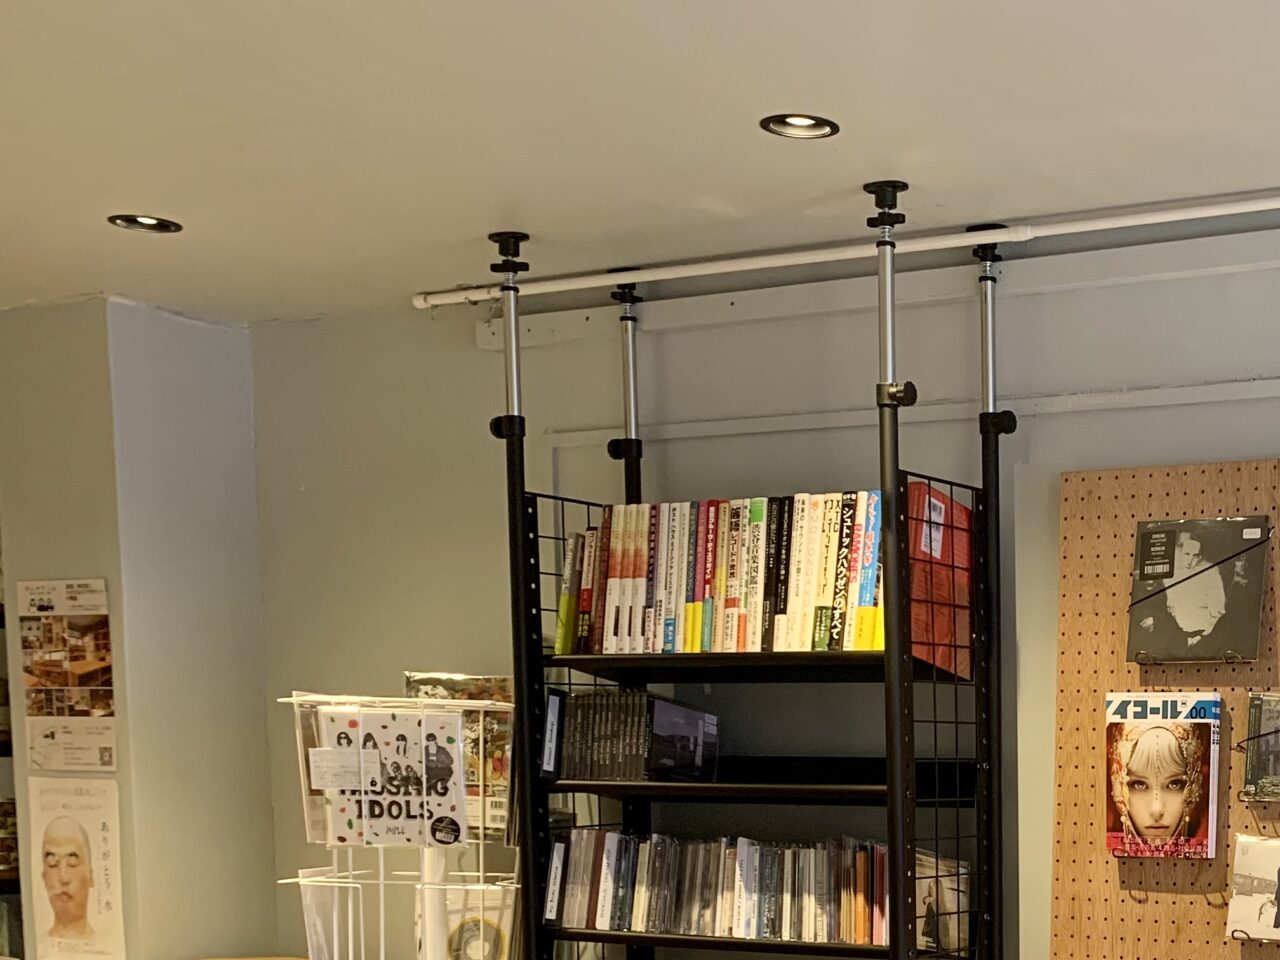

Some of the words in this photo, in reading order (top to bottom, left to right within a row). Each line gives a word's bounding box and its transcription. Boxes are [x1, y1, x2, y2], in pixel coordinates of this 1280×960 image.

[831, 507, 853, 639] シュトックハウゼンのすべて
[849, 523, 862, 584] RAMONES
[1112, 700, 1183, 719] イコール
[1190, 706, 1207, 719] 00
[355, 800, 434, 819] IDOLS
